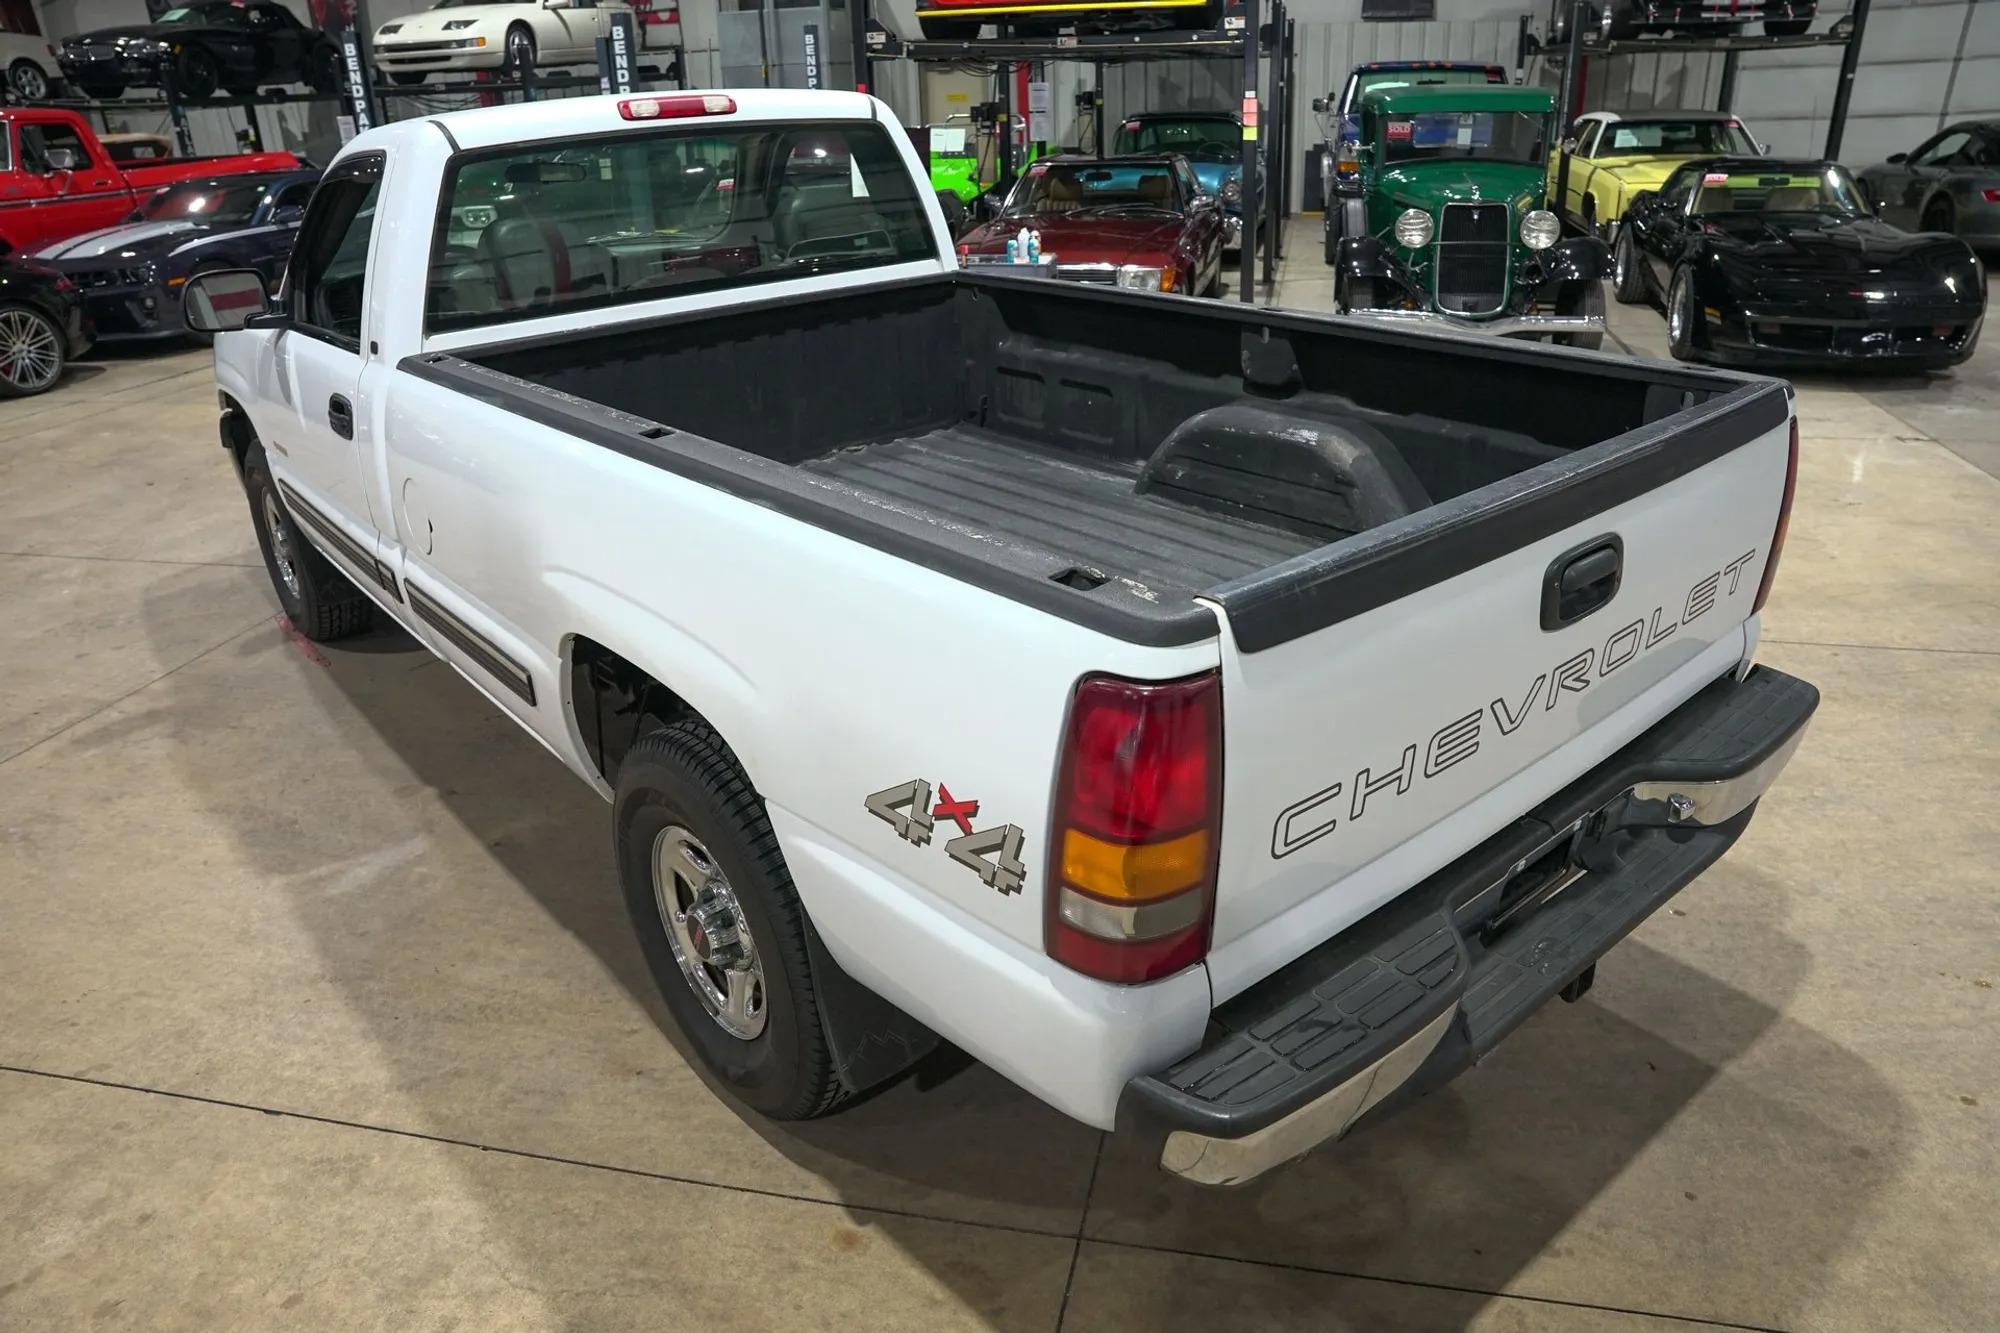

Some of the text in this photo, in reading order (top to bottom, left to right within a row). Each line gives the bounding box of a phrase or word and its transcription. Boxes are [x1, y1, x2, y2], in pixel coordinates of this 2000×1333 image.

[805, 34, 817, 91] BENDP
[1387, 125, 1411, 134] SOLD
[1271, 549, 1757, 860] CHEVROLET
